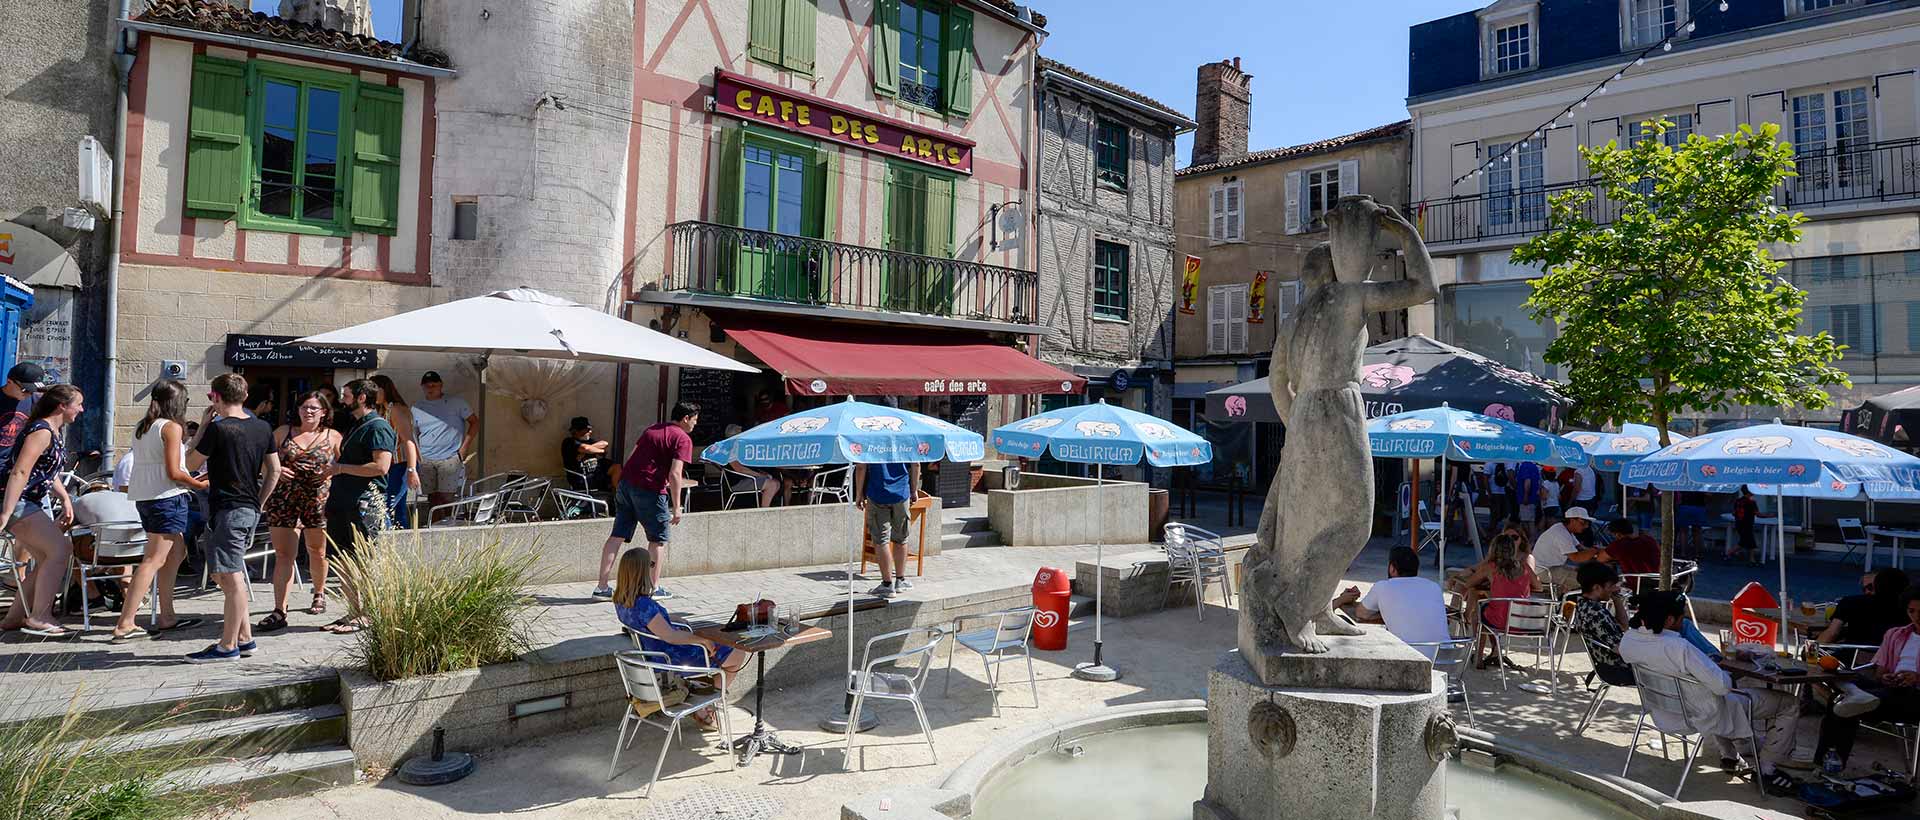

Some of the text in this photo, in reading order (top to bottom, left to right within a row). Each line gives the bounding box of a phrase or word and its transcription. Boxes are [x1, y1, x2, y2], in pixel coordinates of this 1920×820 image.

[736, 90, 961, 165] CAFE DES ARTS
[238, 338, 260, 348] Happy
[948, 379, 964, 393] des
[967, 379, 987, 393] arts
[744, 442, 821, 461] DELIRIUM
[1059, 443, 1133, 461] DELIRIUM
[1370, 438, 1434, 453] ELIRIUM
[1475, 443, 1519, 452] Belgisch bier
[1628, 462, 1679, 479] DELIRIUM
[1722, 466, 1782, 475] Belgisch bier
